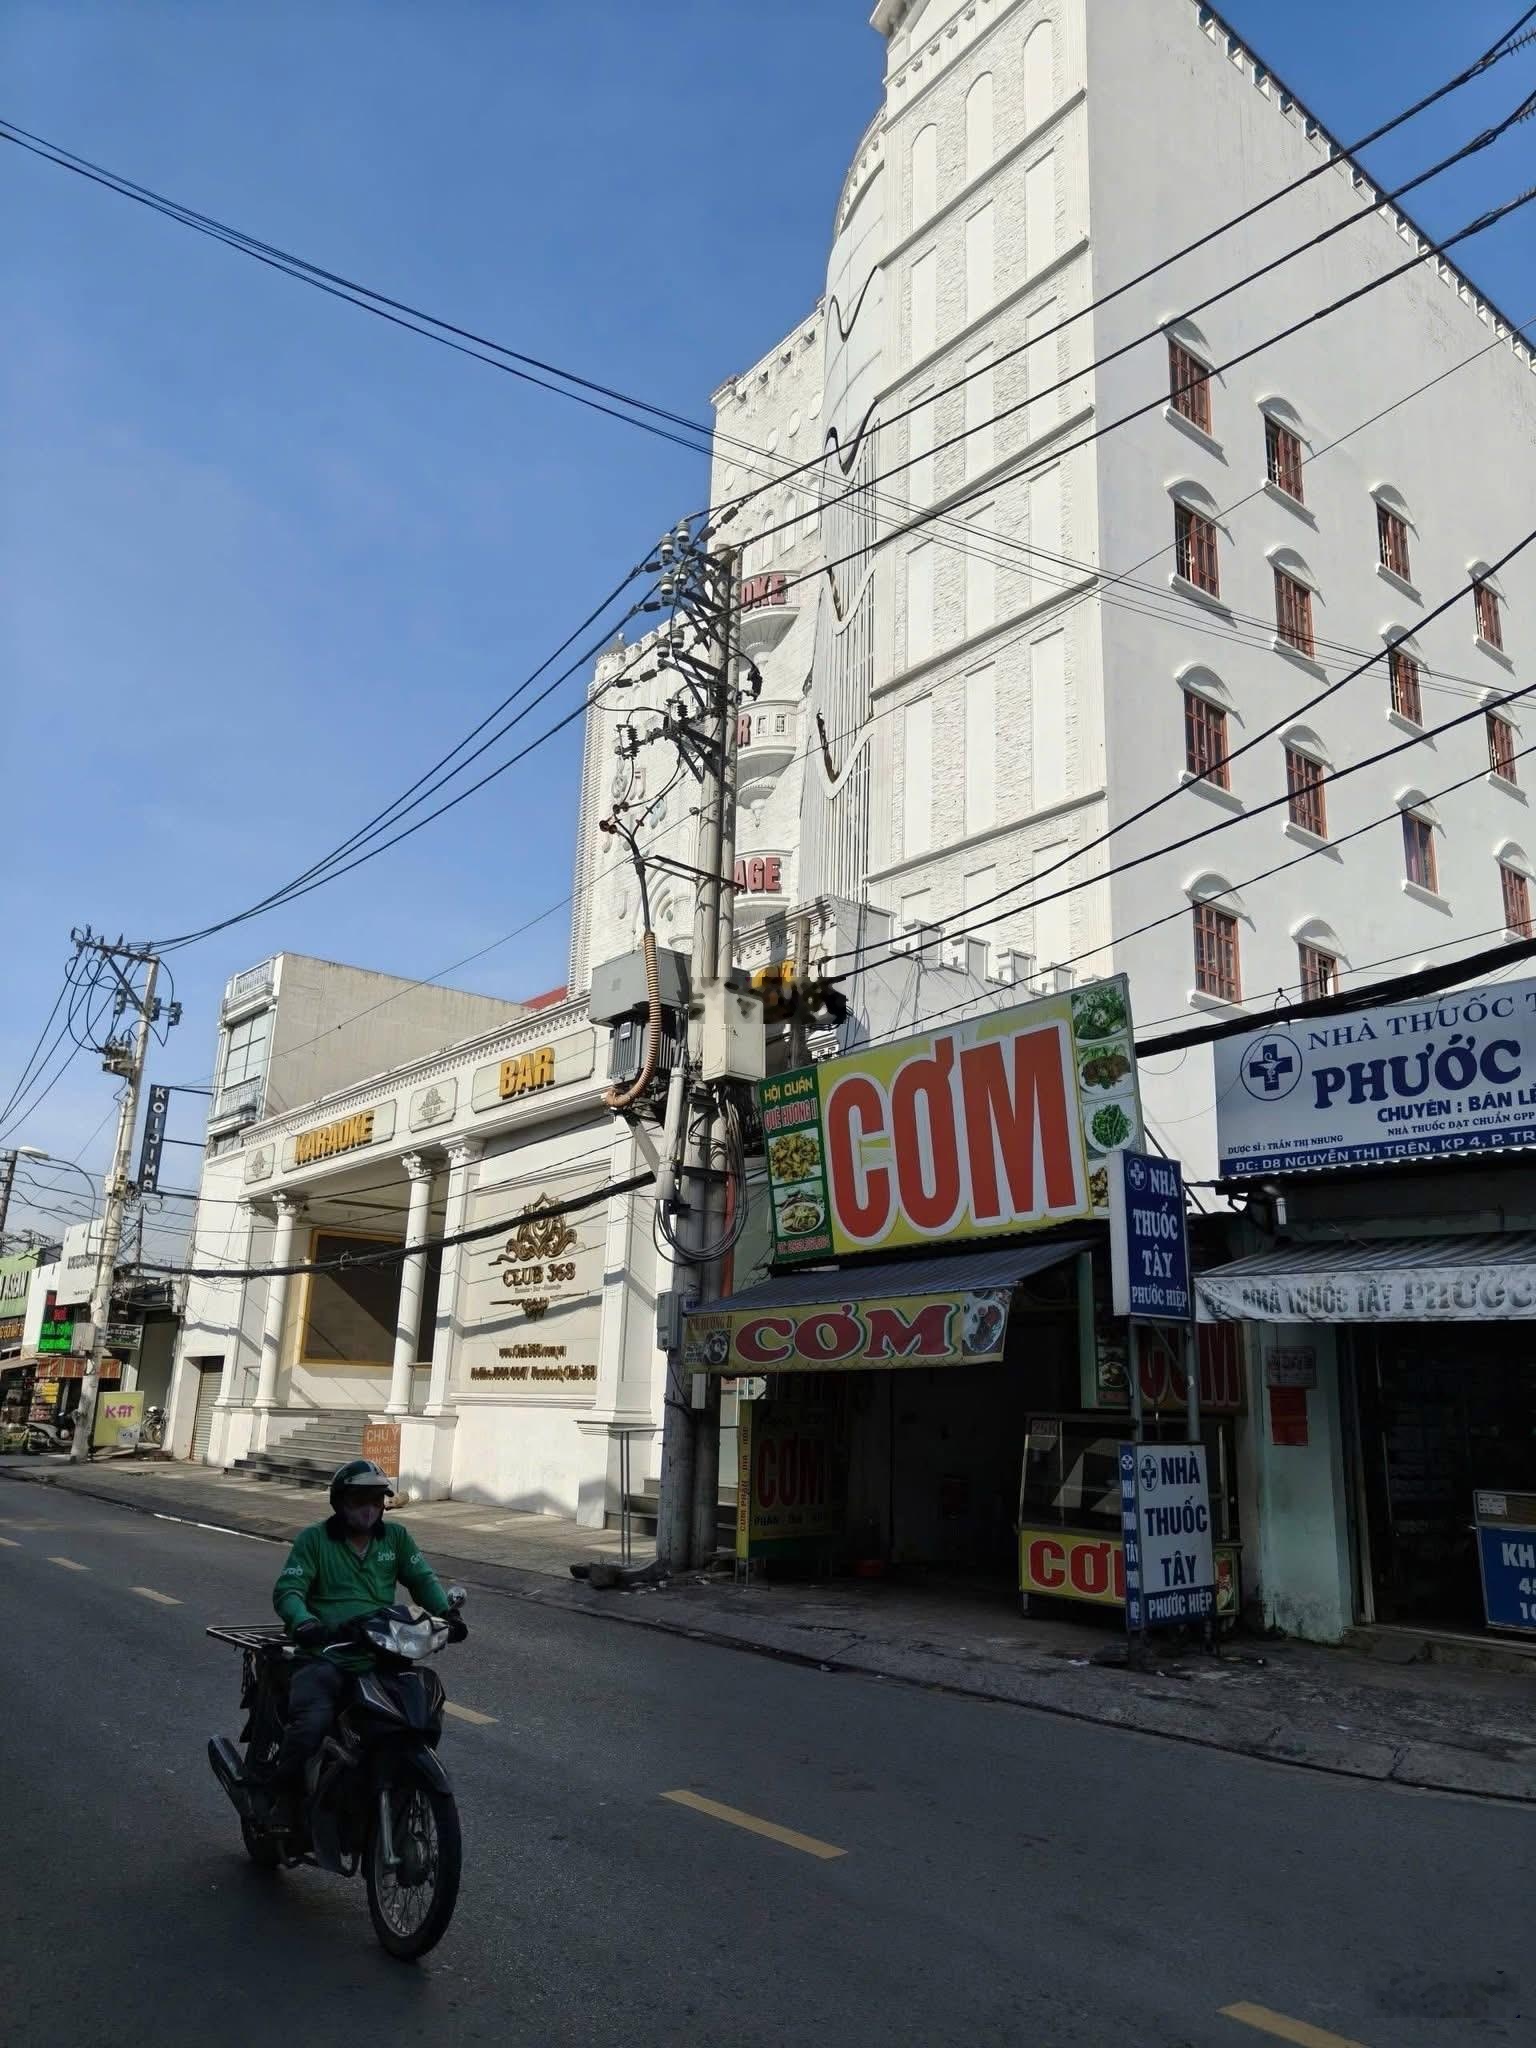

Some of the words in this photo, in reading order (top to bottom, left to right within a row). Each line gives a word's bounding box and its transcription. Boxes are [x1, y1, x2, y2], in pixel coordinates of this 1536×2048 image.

[1308, 1017, 1379, 1050] NHÀ
[1387, 993, 1514, 1036] THUỐC
[498, 1047, 556, 1100] BAR
[1312, 1033, 1522, 1109] PHƯỚC
[1377, 1099, 1451, 1123] CHUYÊN
[1387, 1126, 1409, 1137] NHÀ
[1412, 1119, 1446, 1134] THUỐC
[1448, 1119, 1469, 1131] ĐẠT
[1472, 1111, 1511, 1126] CHUẨN
[1513, 1111, 1535, 1122] GPP
[143, 1087, 166, 1193] KOIJIMA
[294, 1109, 375, 1165] KARAOKE
[827, 1024, 1078, 1240] CƠM
[1311, 1135, 1344, 1147] NHUNG
[1235, 1160, 1259, 1173] ĐC:
[1263, 1158, 1281, 1170] D8
[1353, 1147, 1380, 1161] THỊ
[1441, 1137, 1465, 1151] KP
[1491, 1133, 1505, 1145] P.
[1149, 1165, 1180, 1198] NHÀ
[1133, 1202, 1178, 1240] THUỐC
[503, 1266, 544, 1287] CLUB
[1142, 1243, 1173, 1278] TÂY
[1131, 1283, 1165, 1306] PHƯỚC
[1166, 1284, 1187, 1313] HIỆP
[735, 1303, 959, 1365] CƠM
[1160, 1451, 1201, 1485] NHÀ
[1144, 1495, 1208, 1537] THUỐC
[1160, 1550, 1197, 1587] TÂY
[1148, 1591, 1187, 1620] PHƯỚC
[1188, 1588, 1212, 1619] HIỆP
